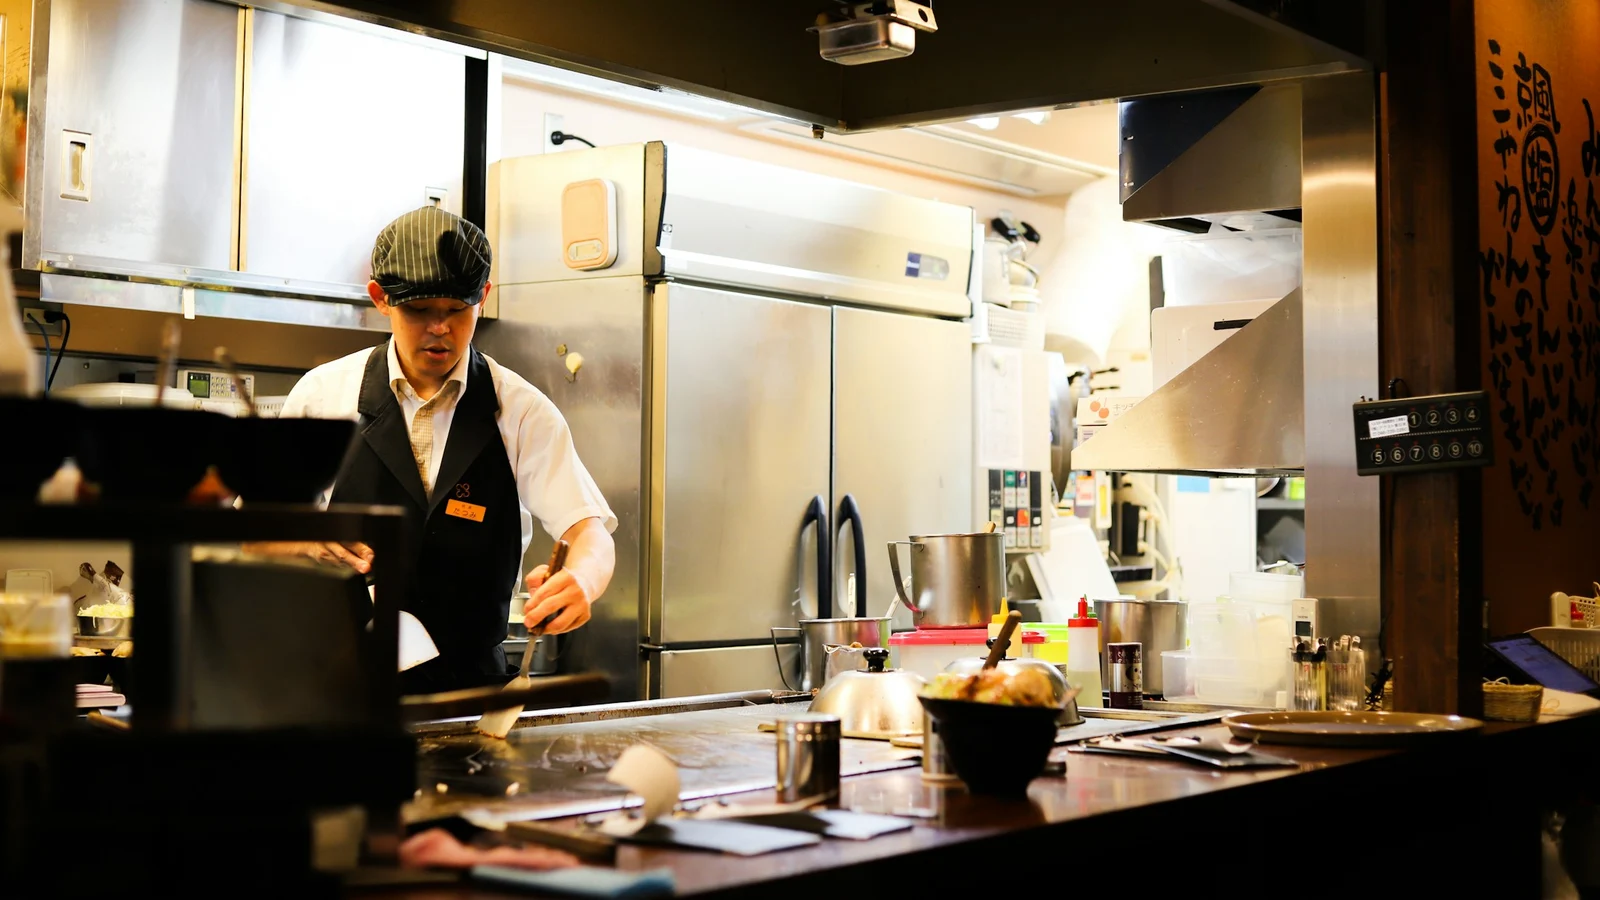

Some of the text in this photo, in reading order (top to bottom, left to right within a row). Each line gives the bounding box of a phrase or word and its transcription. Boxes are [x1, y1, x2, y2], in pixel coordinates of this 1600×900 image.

[1411, 409, 1475, 424] 1 2 3 4
[1375, 444, 1481, 462] 5 6 7 8 9 10
